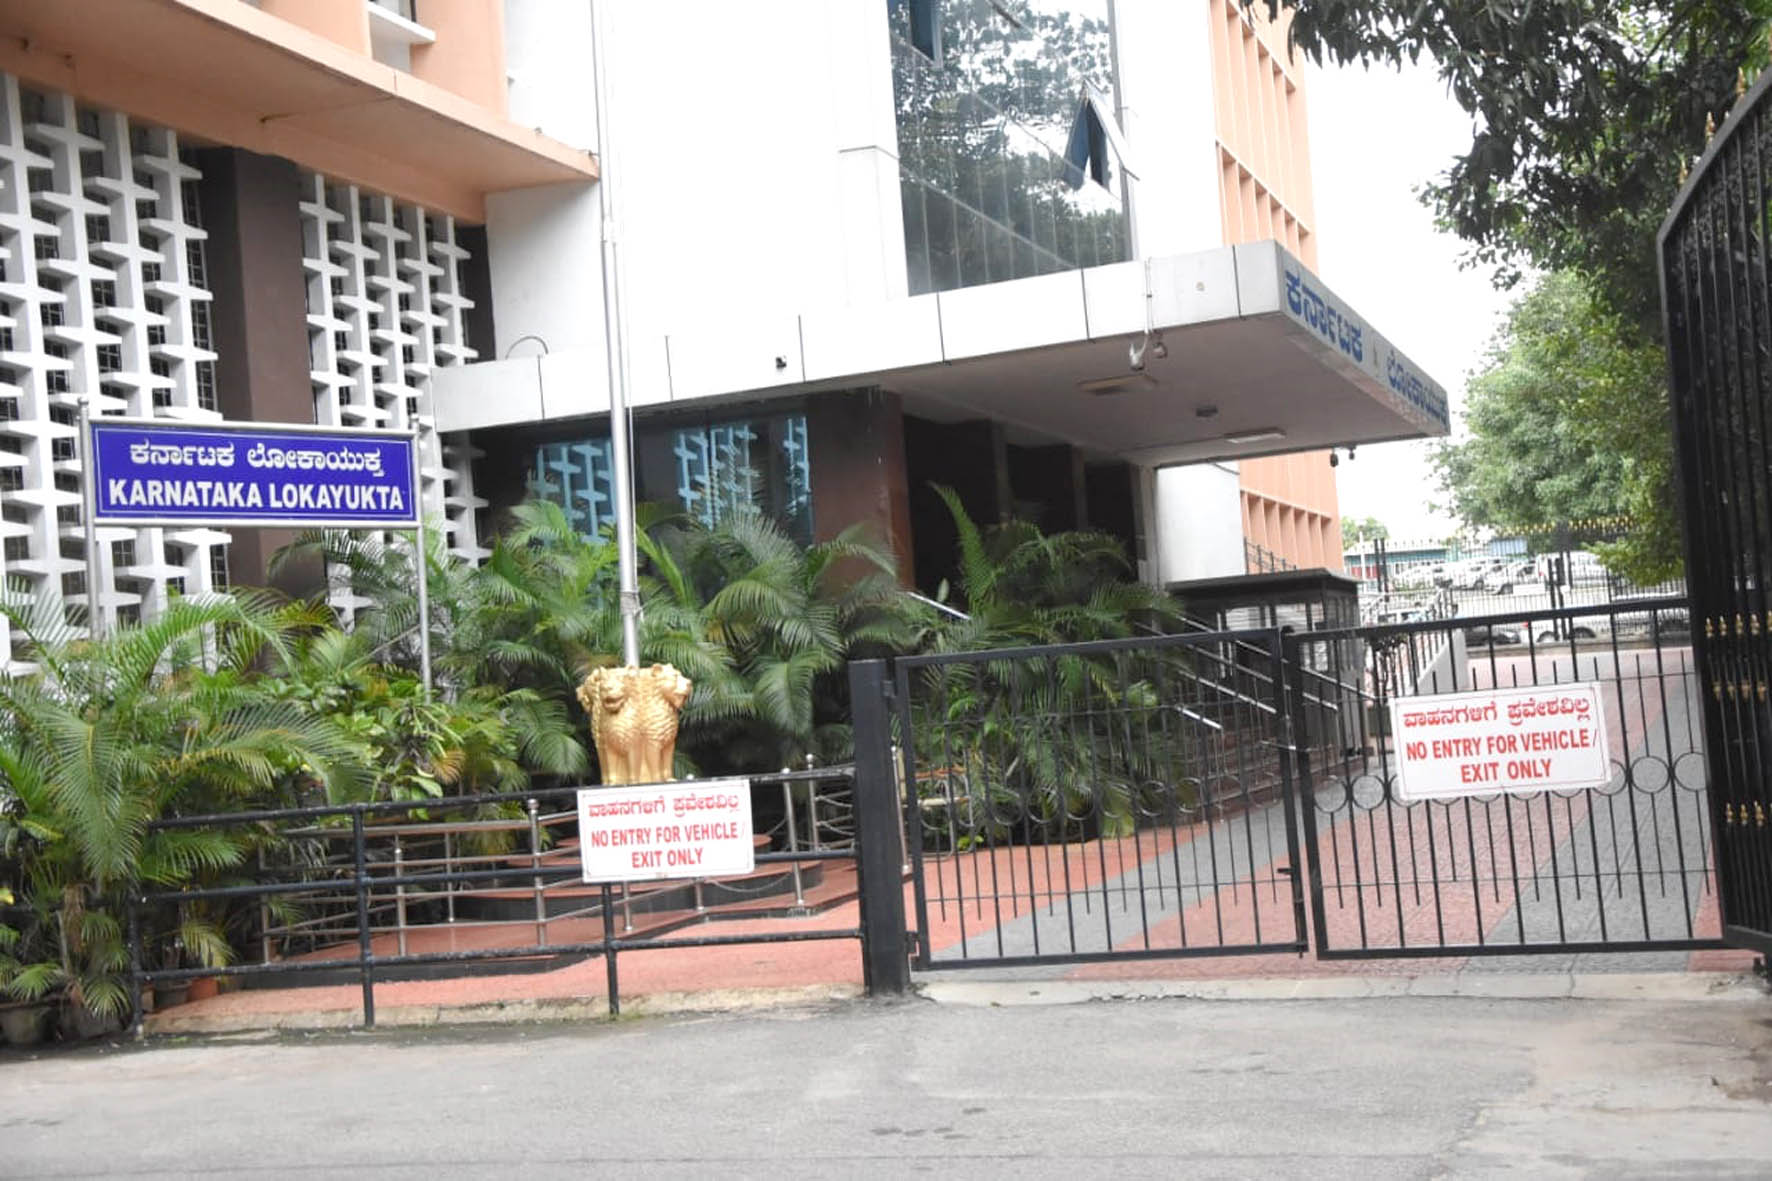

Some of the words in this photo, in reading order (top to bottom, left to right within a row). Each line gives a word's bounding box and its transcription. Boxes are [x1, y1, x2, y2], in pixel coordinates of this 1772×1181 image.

[130, 439, 235, 467] ಕರ್ನಾಟಕ
[247, 442, 385, 477] ಲೋಕಾಯುಕ್ತ
[109, 478, 264, 508] KARNATAKA
[268, 483, 404, 510] LOKAYUKTA
[1406, 740, 1428, 761] NO
[1431, 737, 1481, 760] ENTRY
[1487, 734, 1518, 755] FOR
[1460, 761, 1500, 784] EXIT
[1507, 758, 1552, 781] ONLY
[591, 829, 609, 848] NO
[611, 828, 651, 847] ENTRY
[655, 825, 681, 844] FOR
[684, 822, 739, 842] VEHICLE
[631, 850, 663, 868] EXIT
[667, 847, 704, 866] ONLY
